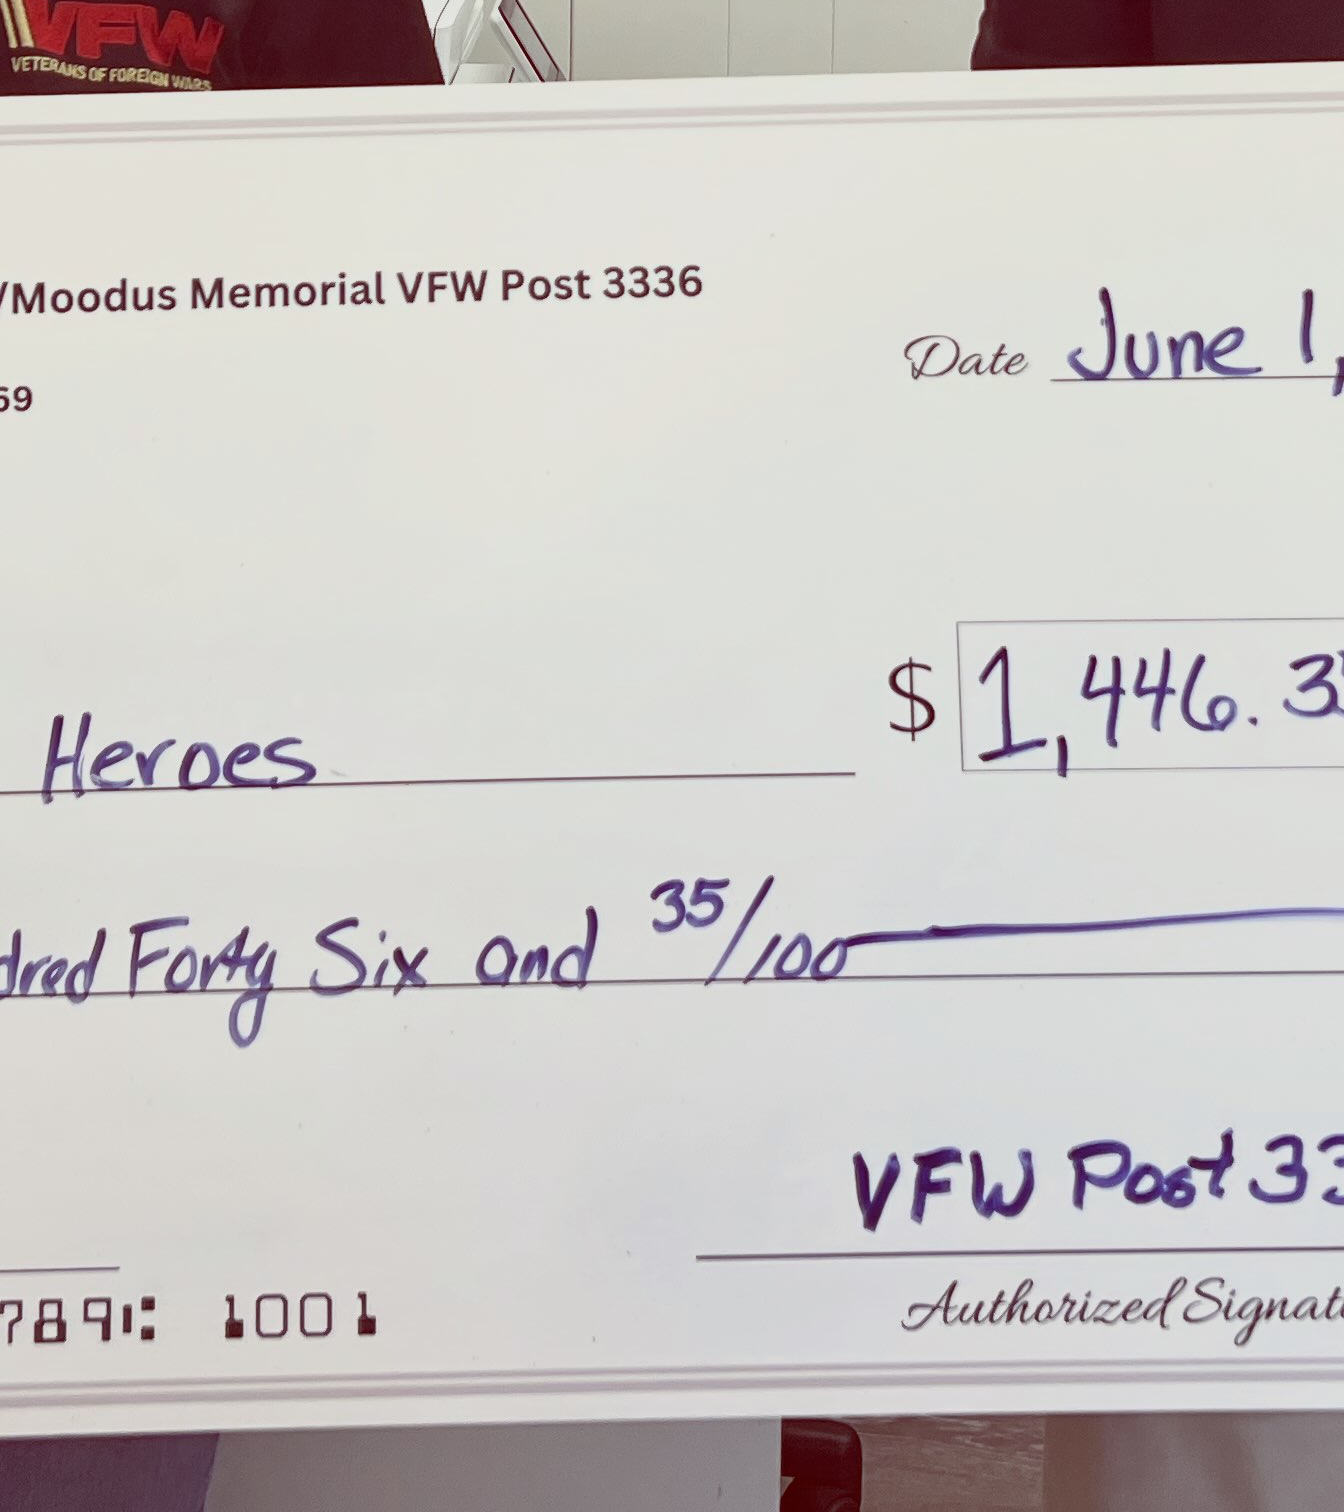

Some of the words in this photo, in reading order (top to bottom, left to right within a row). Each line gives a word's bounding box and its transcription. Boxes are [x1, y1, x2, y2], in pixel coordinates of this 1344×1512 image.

[11, 56, 87, 80] VETERANS
[88, 67, 108, 82] OF
[109, 67, 170, 88] FOREIGN
[172, 74, 213, 91] WARS
[192, 272, 385, 309] Memorial
[397, 270, 487, 303] VFW
[502, 270, 591, 300] Post
[604, 265, 702, 298] 3336
[905, 334, 1028, 380] Date
[1067, 287, 1262, 381] June
[888, 658, 937, 740] $
[42, 711, 319, 805] Heroes
[128, 915, 277, 1047] Forty
[311, 917, 428, 996] Six
[474, 905, 602, 990] and
[650, 875, 856, 985] 35/100
[853, 1148, 1035, 1232] VFW
[1069, 1128, 1234, 1210] Post
[225, 1290, 380, 1338] 1001
[902, 1277, 1186, 1332] Authorized
